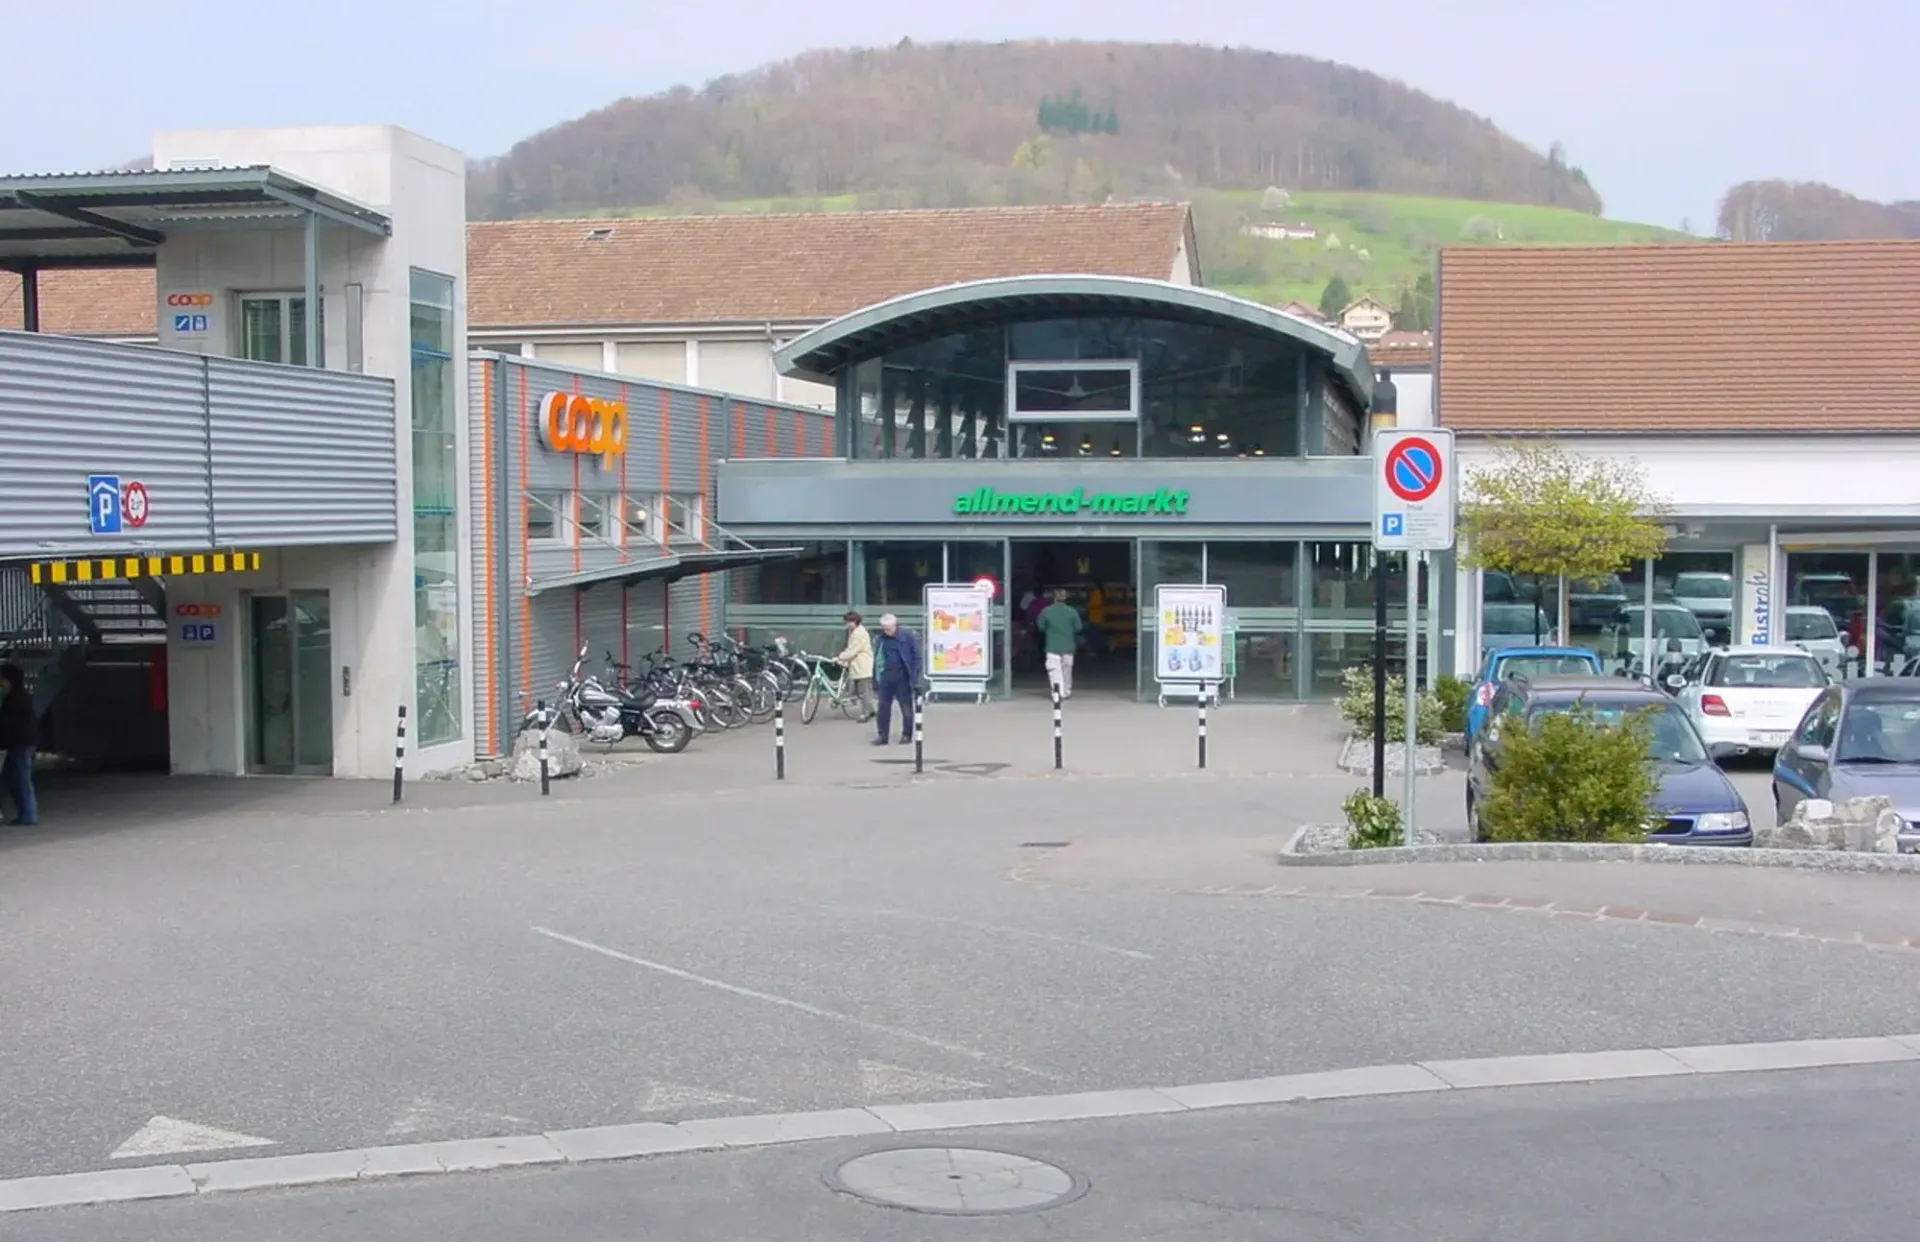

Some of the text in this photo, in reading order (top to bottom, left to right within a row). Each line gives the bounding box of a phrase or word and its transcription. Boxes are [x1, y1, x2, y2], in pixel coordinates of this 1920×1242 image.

[167, 293, 213, 310] coop
[542, 391, 627, 472] coop
[99, 493, 113, 527] P
[953, 487, 1189, 514] allmend-markt
[1387, 517, 1399, 533] P
[203, 628, 212, 638] P
